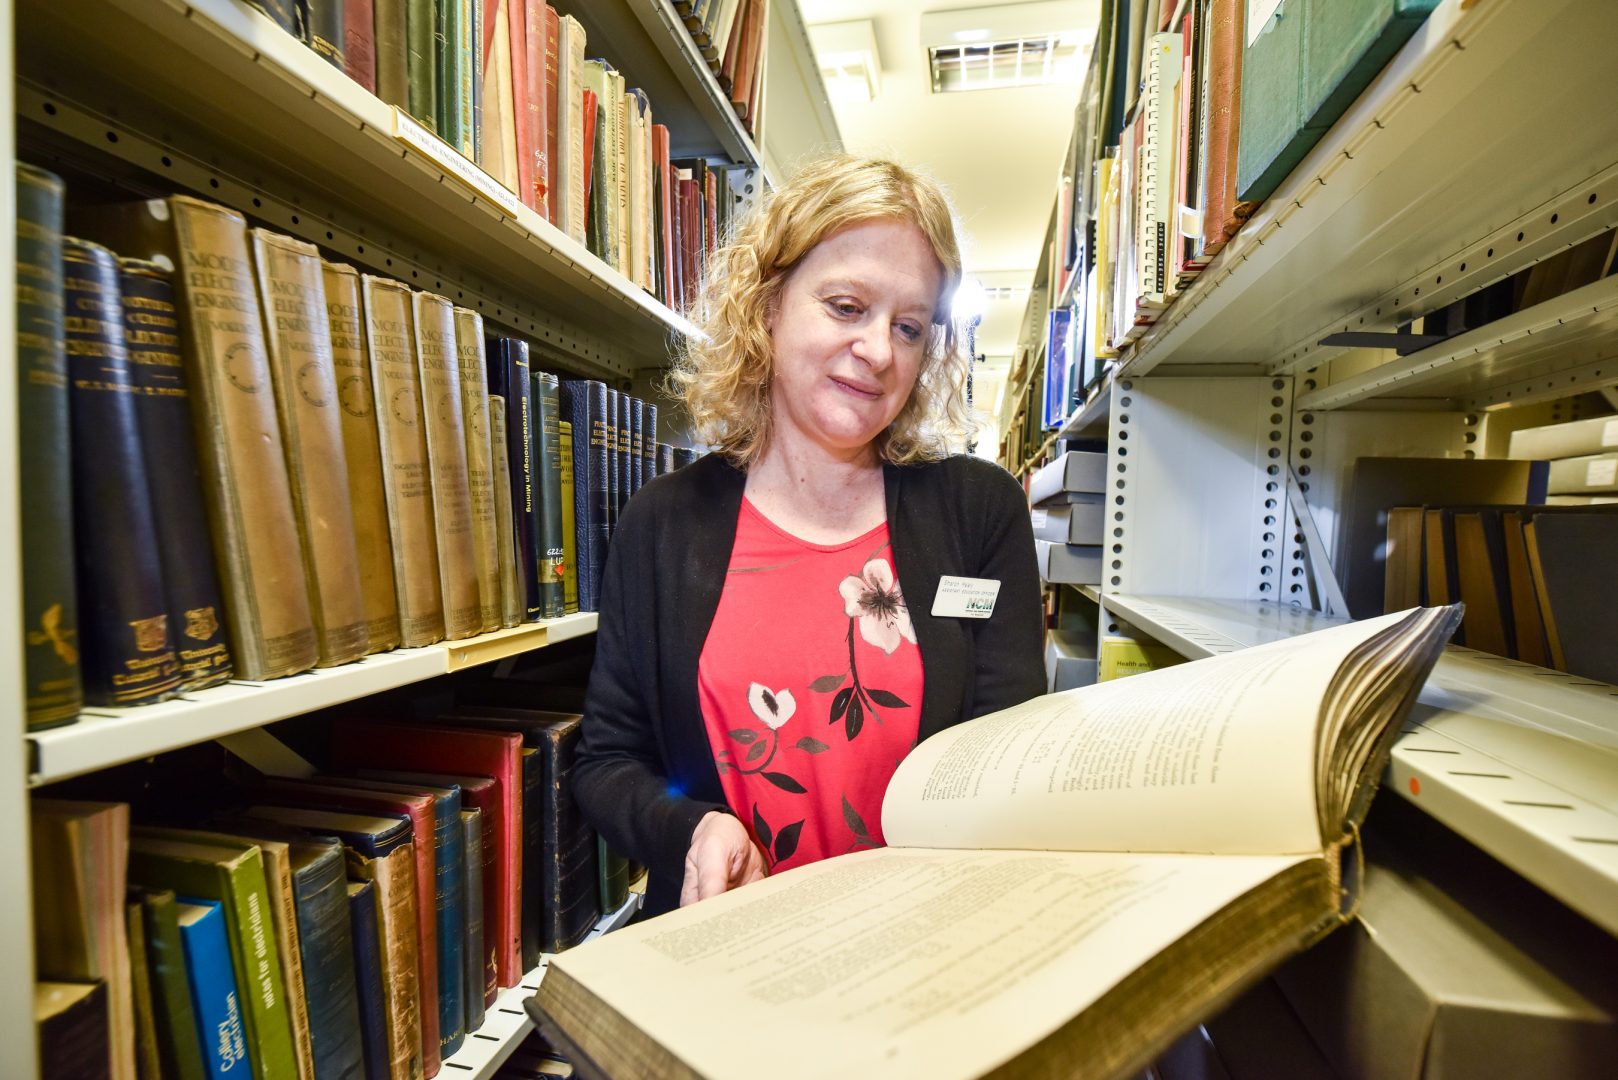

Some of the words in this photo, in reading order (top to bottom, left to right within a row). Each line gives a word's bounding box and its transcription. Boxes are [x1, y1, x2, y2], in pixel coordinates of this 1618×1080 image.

[521, 396, 530, 473] Electrotechnology
[258, 959, 270, 980] for
[262, 976, 275, 1009] notes
[226, 990, 245, 1060] electrician
